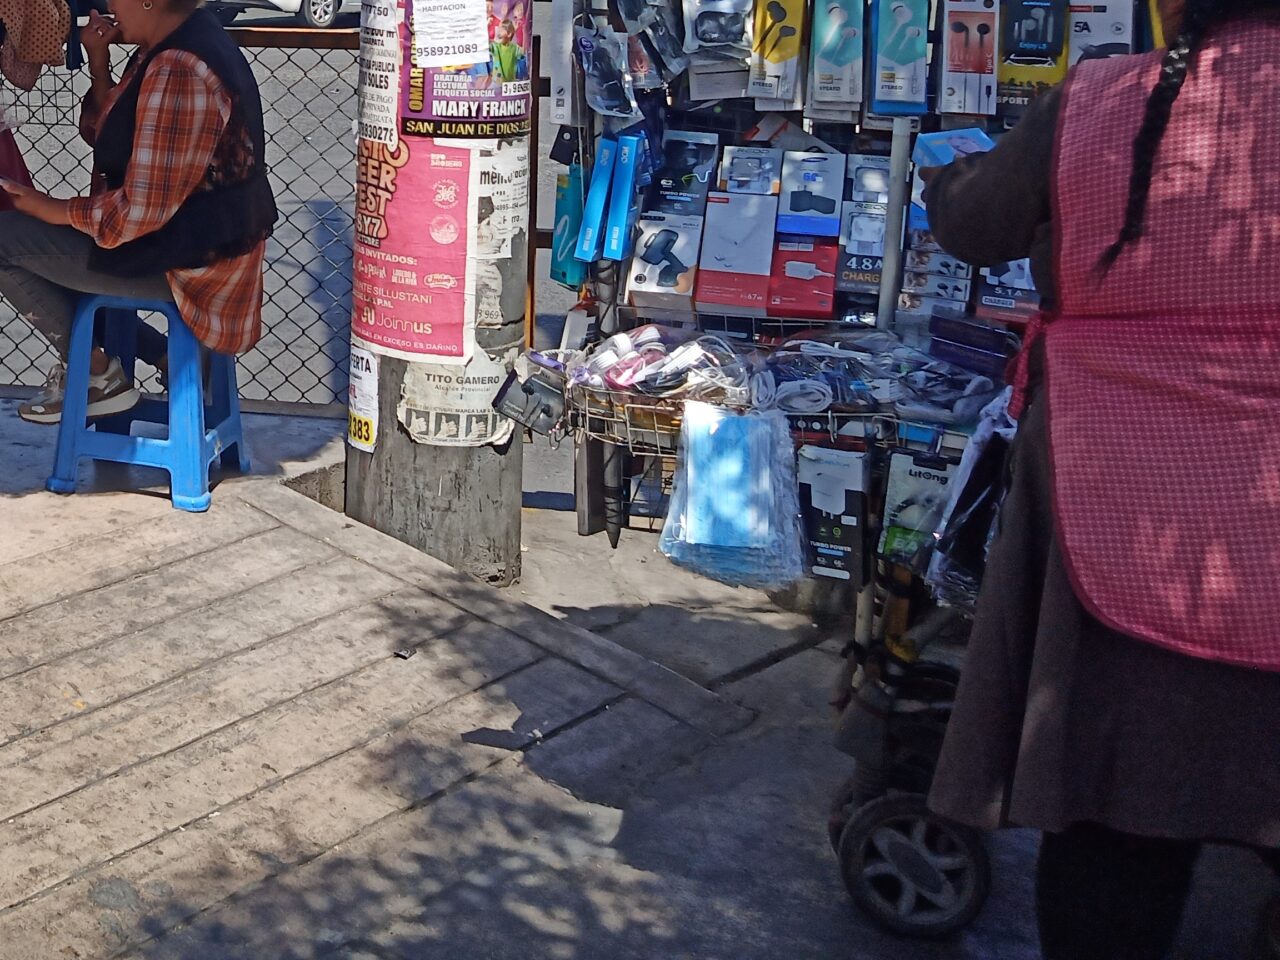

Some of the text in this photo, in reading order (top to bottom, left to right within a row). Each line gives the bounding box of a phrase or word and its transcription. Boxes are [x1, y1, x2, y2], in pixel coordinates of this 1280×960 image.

[422, 3, 466, 12] HABITACION
[1073, 21, 1092, 33] 5A
[416, 43, 478, 58] 958921089
[372, 60, 395, 73] PUBLICA
[368, 74, 389, 90] SOLES
[409, 66, 423, 111] OMAR
[433, 89, 496, 97] ETIQUETA SOCIAL
[432, 99, 526, 117] MARY FRANCK
[406, 120, 434, 134] SAN
[437, 122, 474, 135] JUAN
[477, 123, 494, 135] DE
[496, 123, 520, 135] DIOS
[365, 248, 418, 266] INVITADOS:
[373, 286, 433, 305] SILLUSTANI
[383, 335, 412, 348] EXCESO
[425, 343, 458, 352] DAÑINO
[424, 372, 500, 385] TITO GAMERO
[830, 542, 852, 553] POWER
